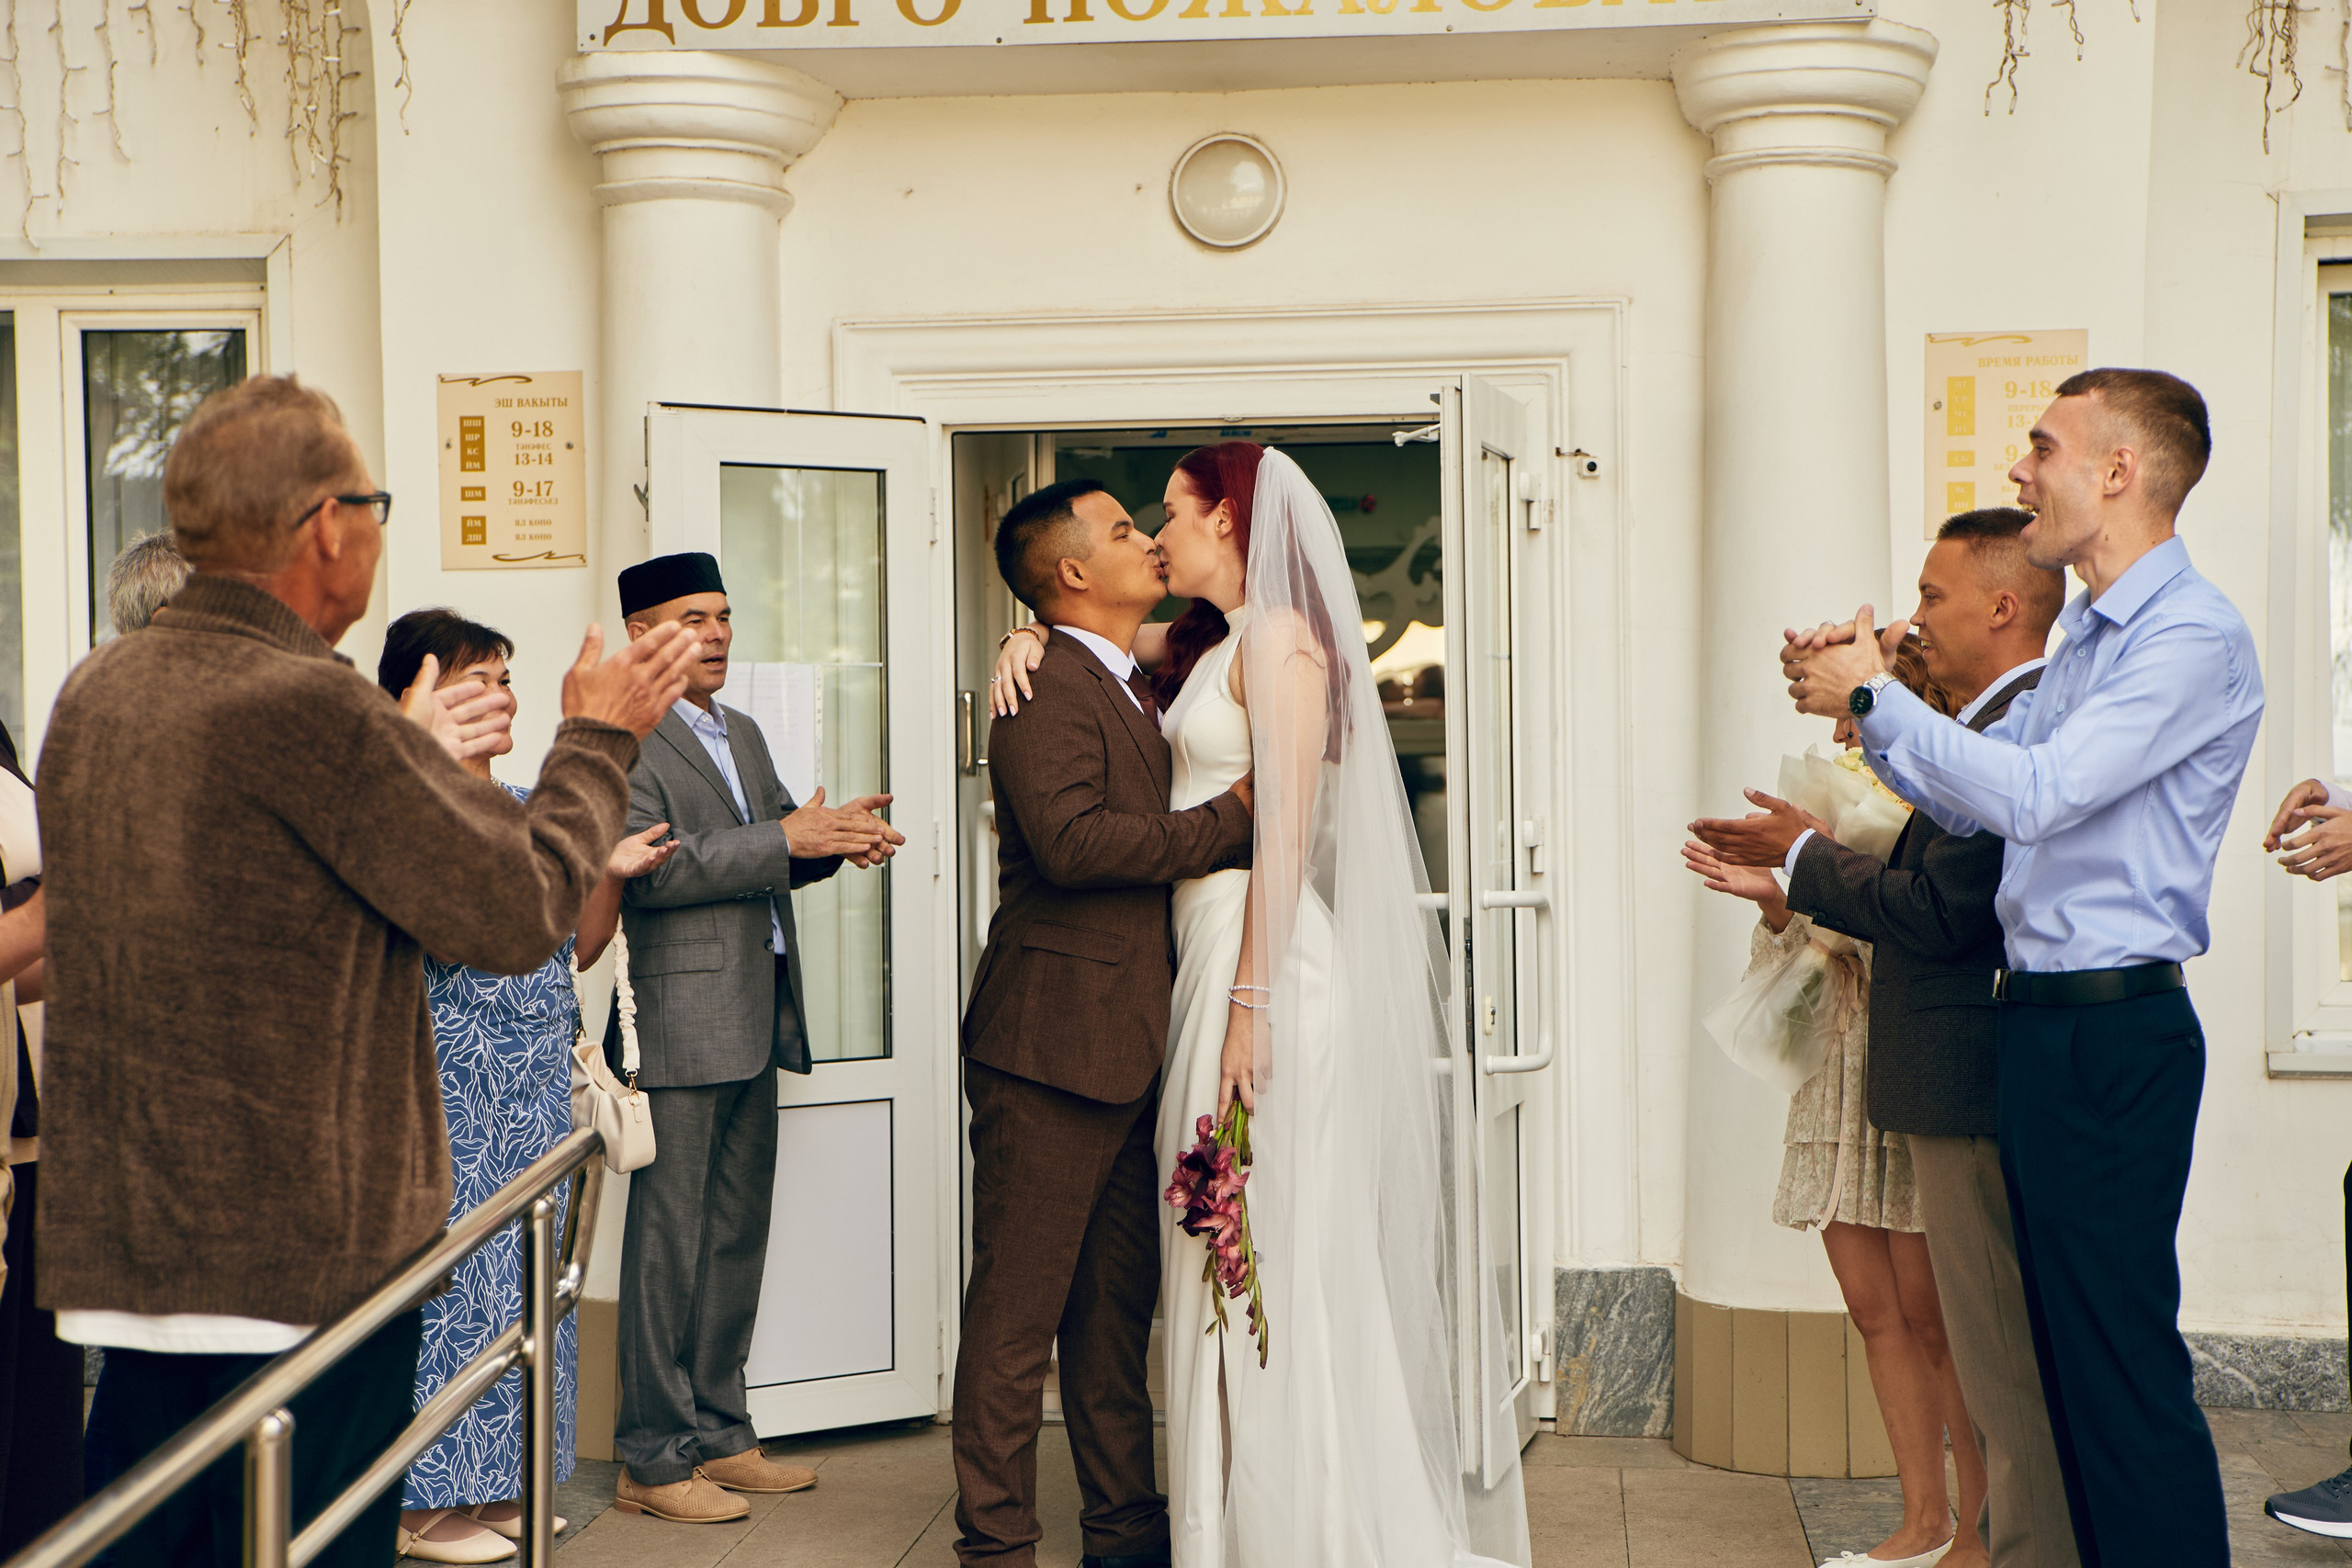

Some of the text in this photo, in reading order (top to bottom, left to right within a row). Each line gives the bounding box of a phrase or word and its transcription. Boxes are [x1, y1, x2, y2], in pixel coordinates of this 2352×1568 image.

[1978, 355, 2078, 367] ВРЕМЯ РАБОТЫ
[2004, 379, 2051, 399] 9-18
[494, 398, 513, 408] ЭШ
[2007, 404, 2048, 412] ПЕРЕРЫ
[511, 420, 553, 438] 9-18
[467, 447, 479, 456] КС
[514, 452, 553, 466] 13-14
[465, 490, 482, 498] ШМ
[513, 480, 554, 497] 9-17
